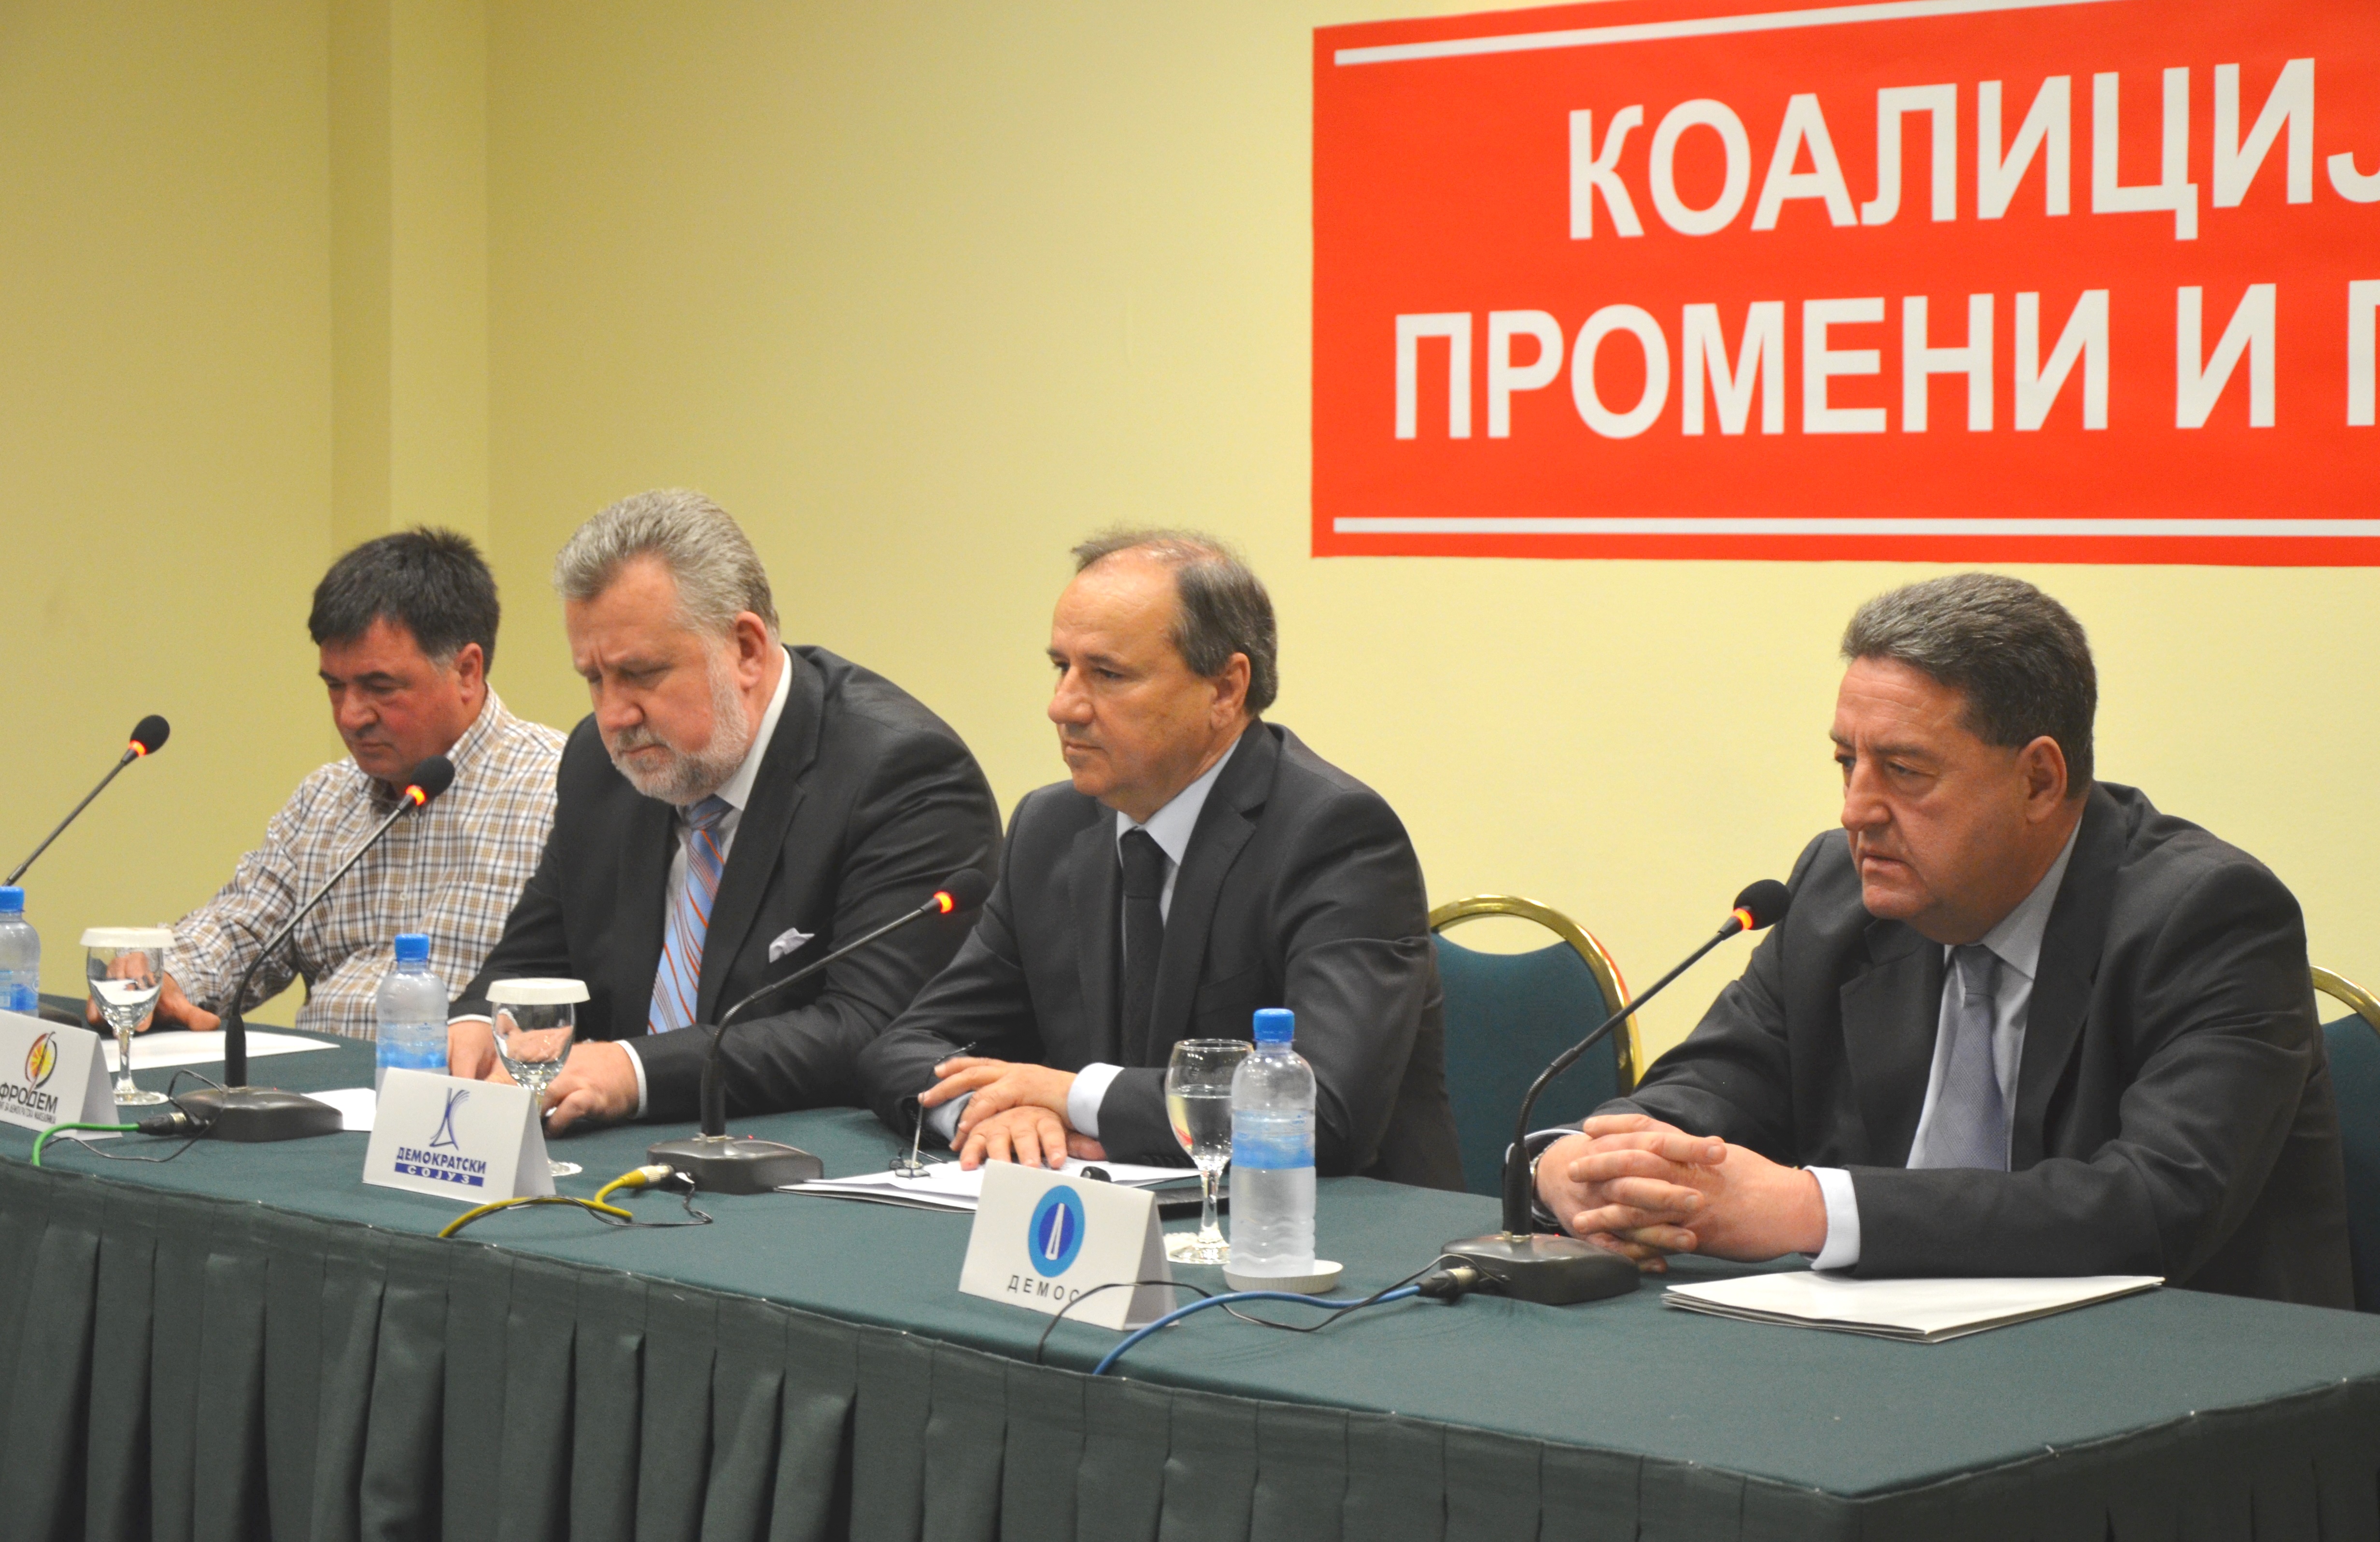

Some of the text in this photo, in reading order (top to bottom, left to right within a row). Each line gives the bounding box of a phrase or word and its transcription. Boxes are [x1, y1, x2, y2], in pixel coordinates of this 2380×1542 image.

[1395, 289, 2109, 439] ПРОМЕНИ
[2176, 283, 2276, 428] И
[397, 1146, 487, 1174] ДЕМОКРАТСКИ
[407, 1165, 470, 1184] СОЈУЗ
